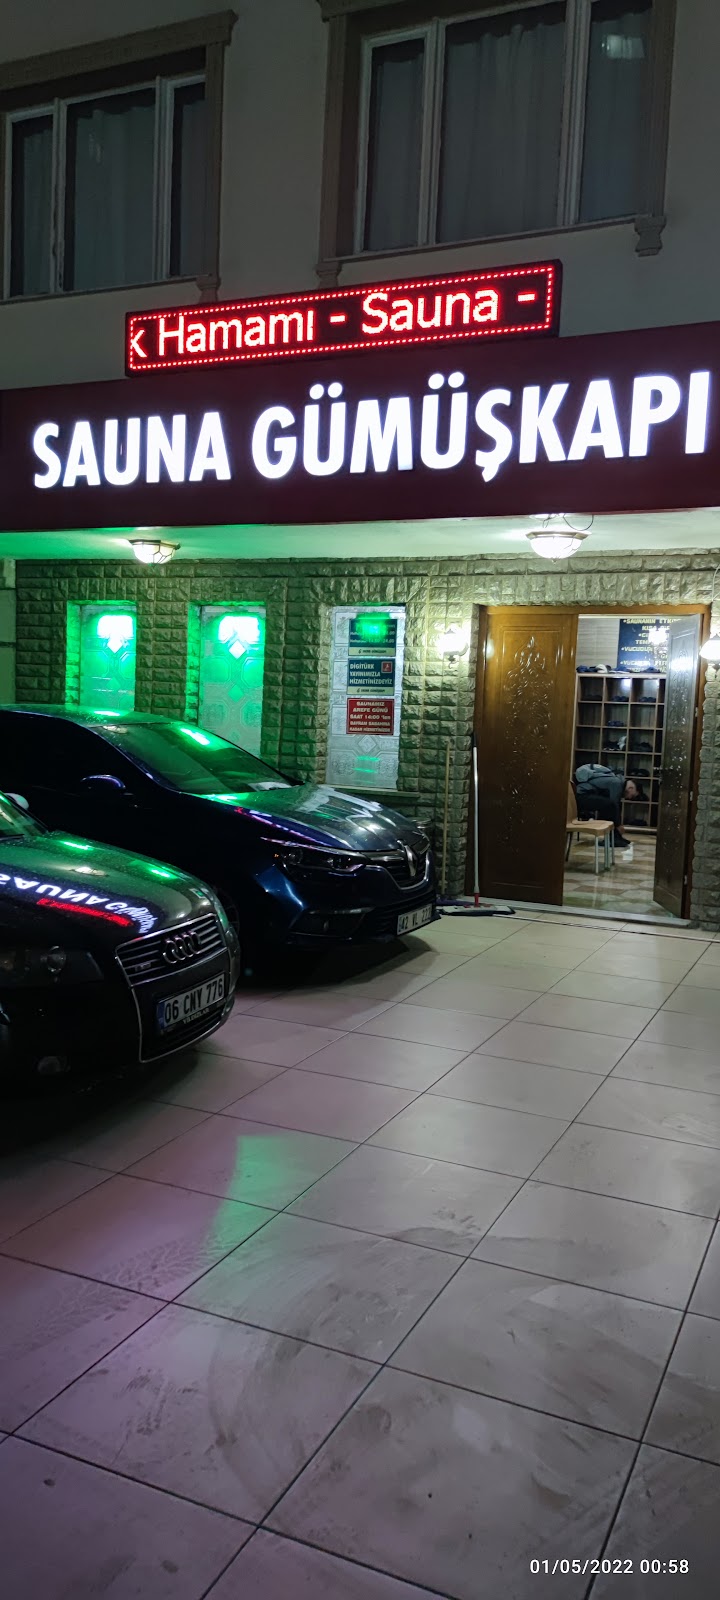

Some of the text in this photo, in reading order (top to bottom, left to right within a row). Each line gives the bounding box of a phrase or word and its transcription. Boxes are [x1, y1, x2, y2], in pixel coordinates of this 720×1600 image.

[158, 310, 314, 356] Hamamı
[362, 288, 499, 335] Sauna
[32, 371, 710, 489] SAUNA GÜMÜŞKAPI
[165, 999, 179, 1024] 06
[206, 978, 224, 1004] 776
